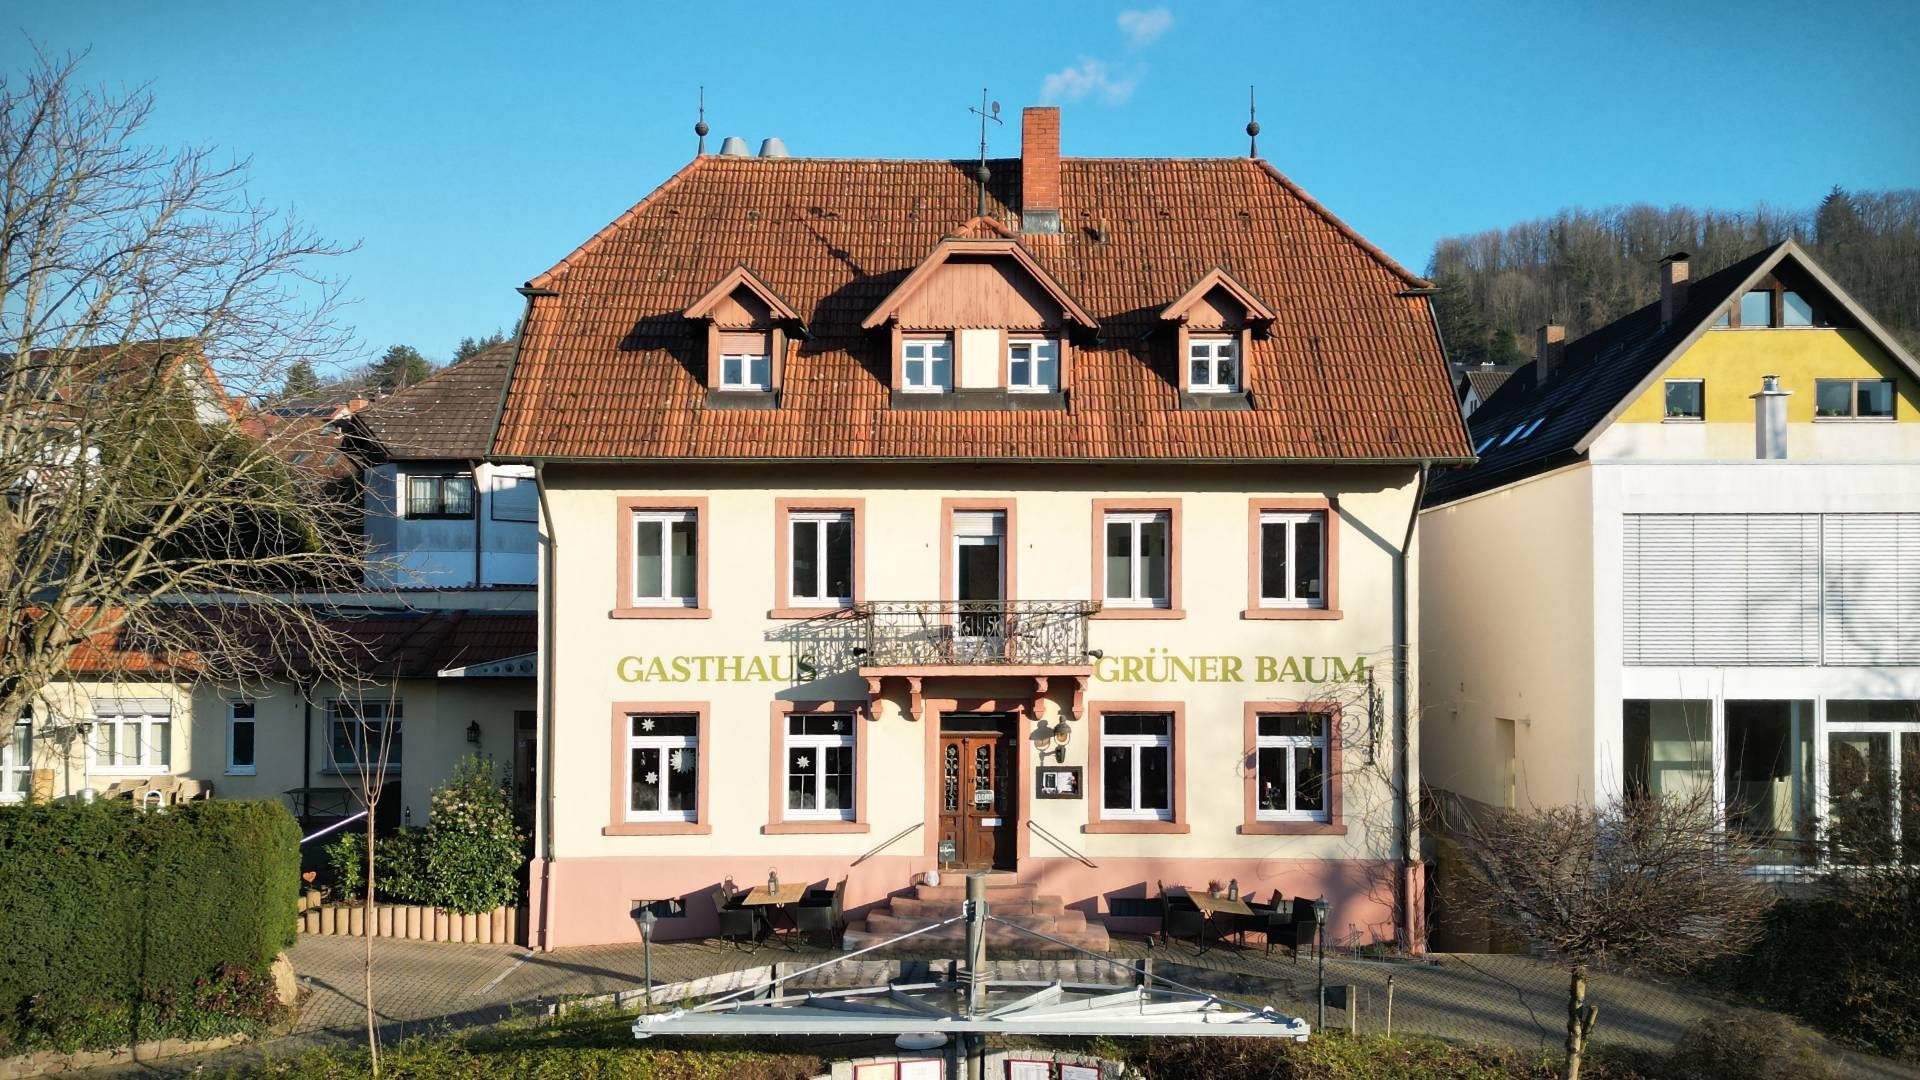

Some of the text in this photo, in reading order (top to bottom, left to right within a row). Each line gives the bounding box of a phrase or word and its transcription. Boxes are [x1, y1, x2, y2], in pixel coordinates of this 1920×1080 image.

[616, 647, 1367, 684] GASTHAUS GRÜNER BAUM
